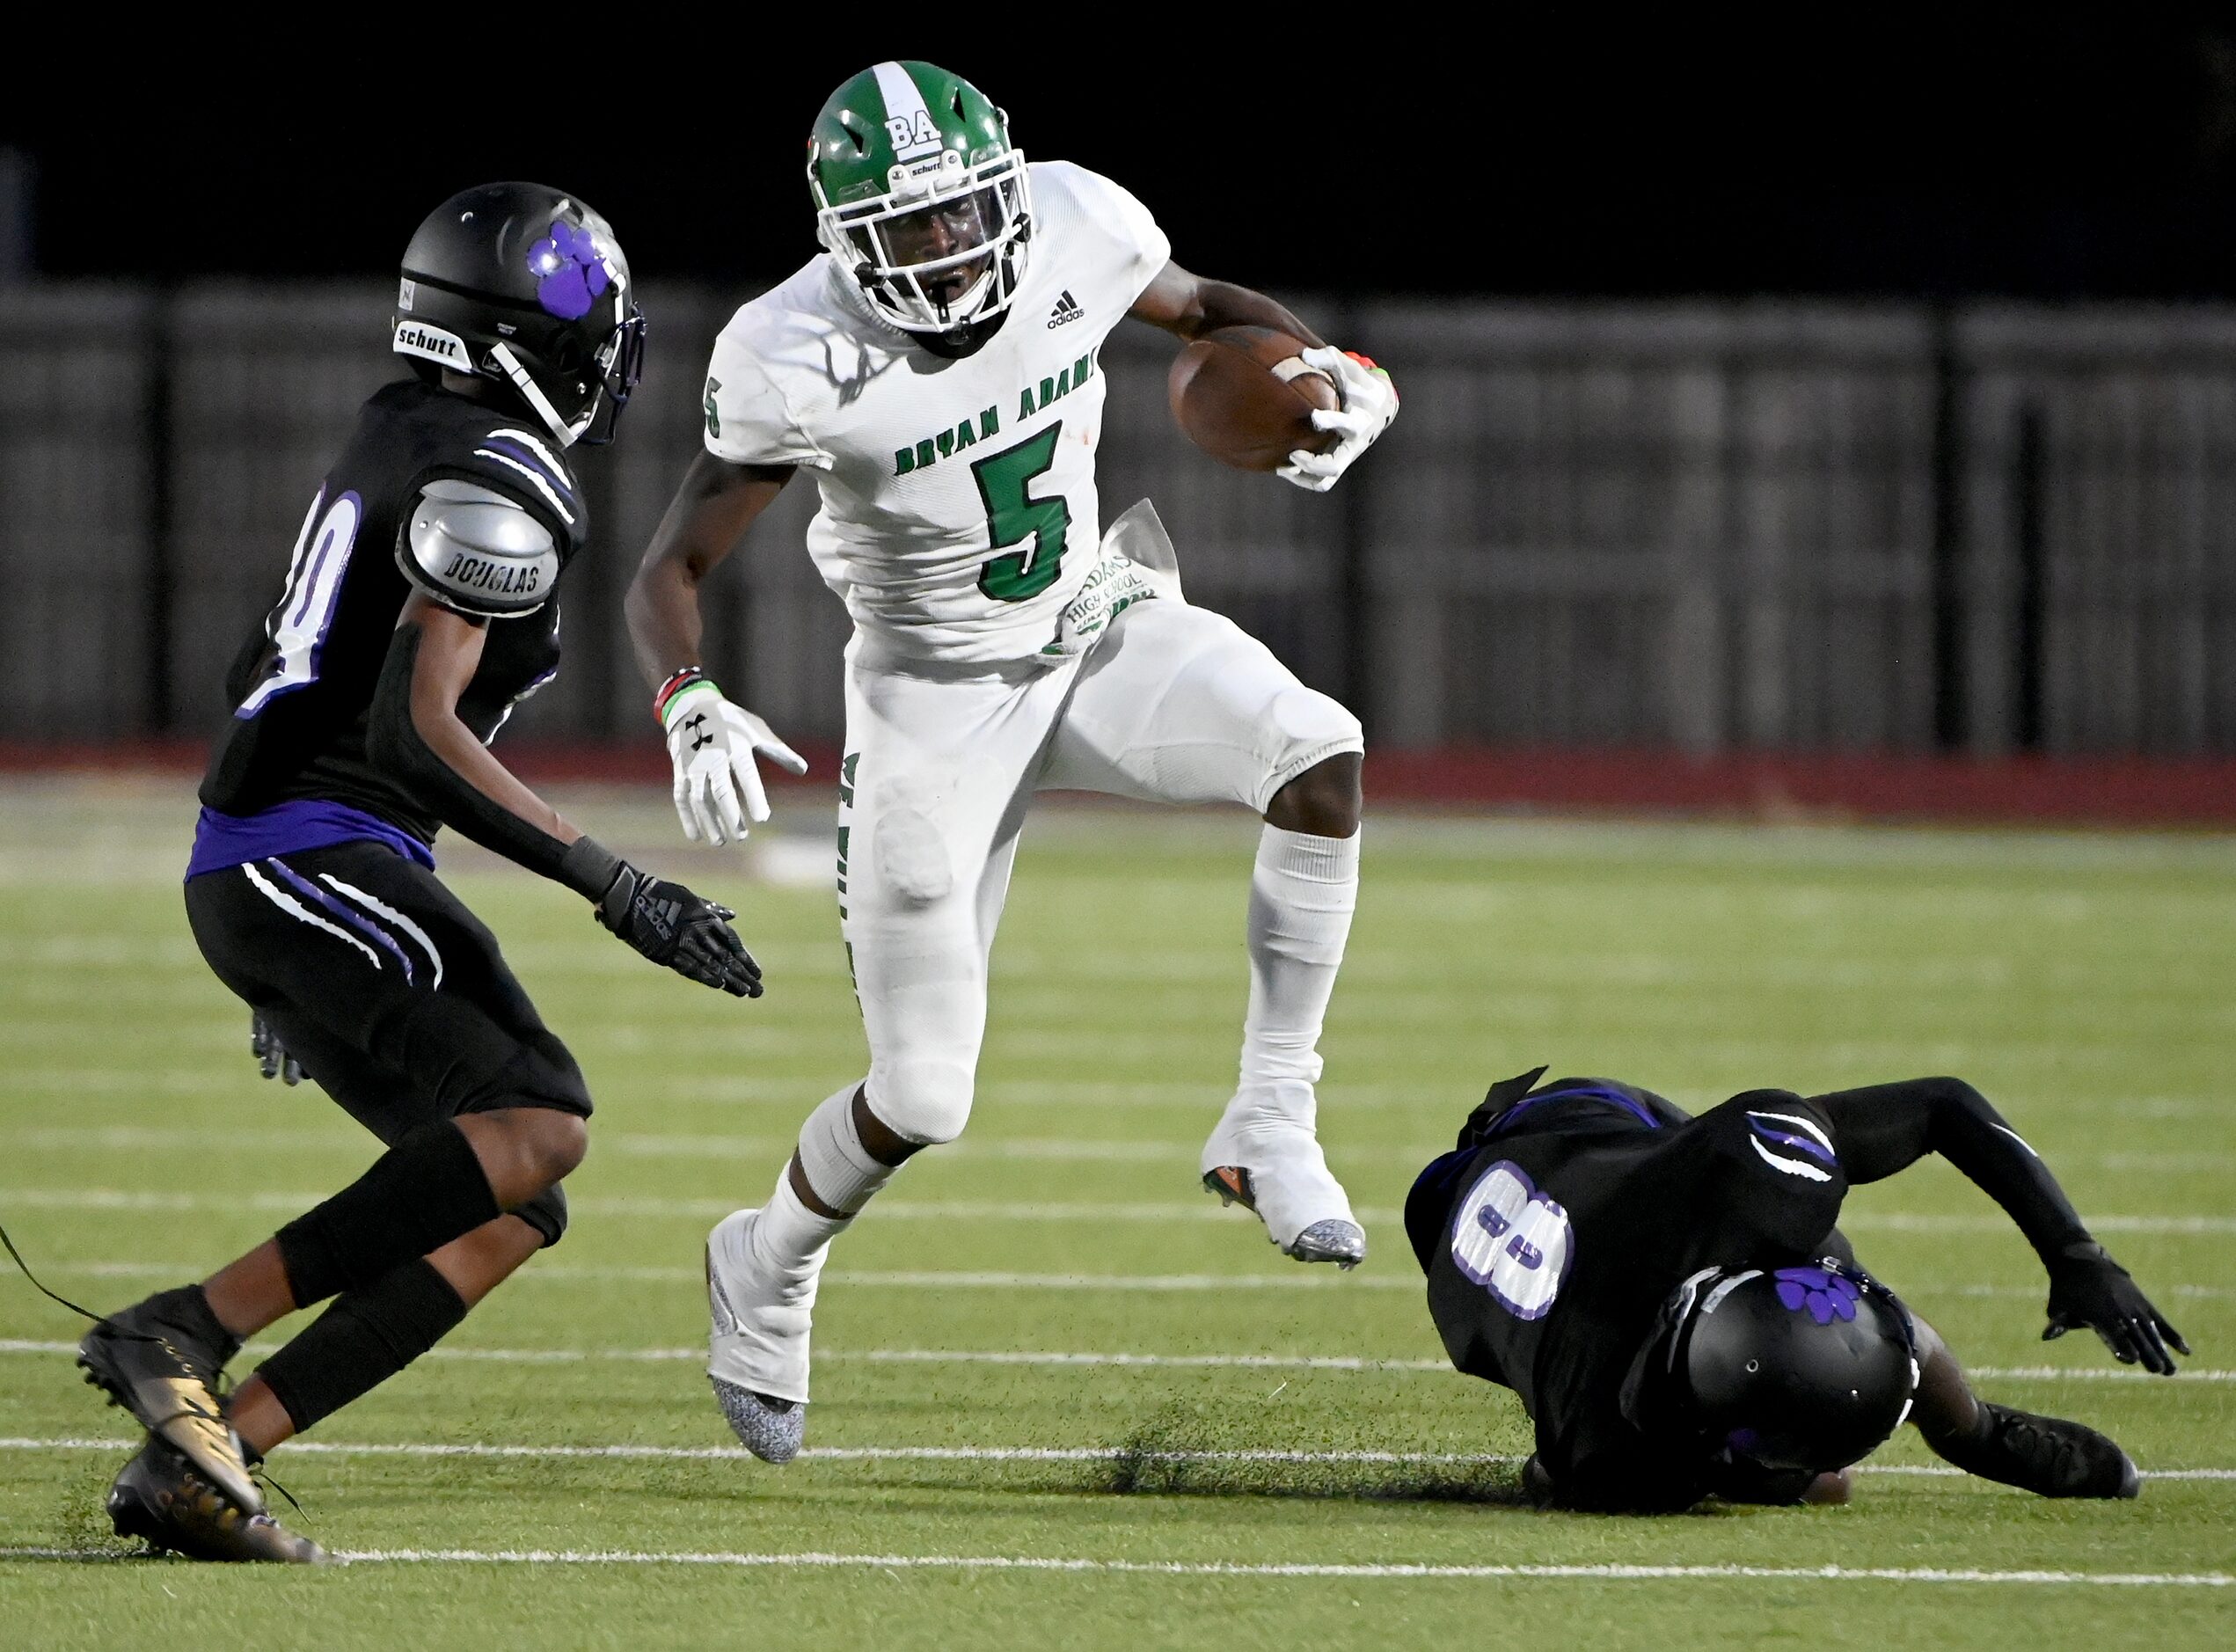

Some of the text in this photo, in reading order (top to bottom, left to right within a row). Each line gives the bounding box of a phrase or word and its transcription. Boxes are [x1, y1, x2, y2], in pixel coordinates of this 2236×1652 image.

[884, 109, 942, 151] BA
[912, 162, 941, 177] schutt
[1047, 308, 1085, 330] adidas
[398, 328, 457, 357] schutt
[894, 405, 1000, 476] BRYAN
[970, 419, 1073, 603] 5
[443, 552, 539, 594] DOUGLAS
[1065, 596, 1101, 624] HIGH
[1103, 573, 1142, 599] SHOOL
[1452, 1159, 1575, 1321] 8
